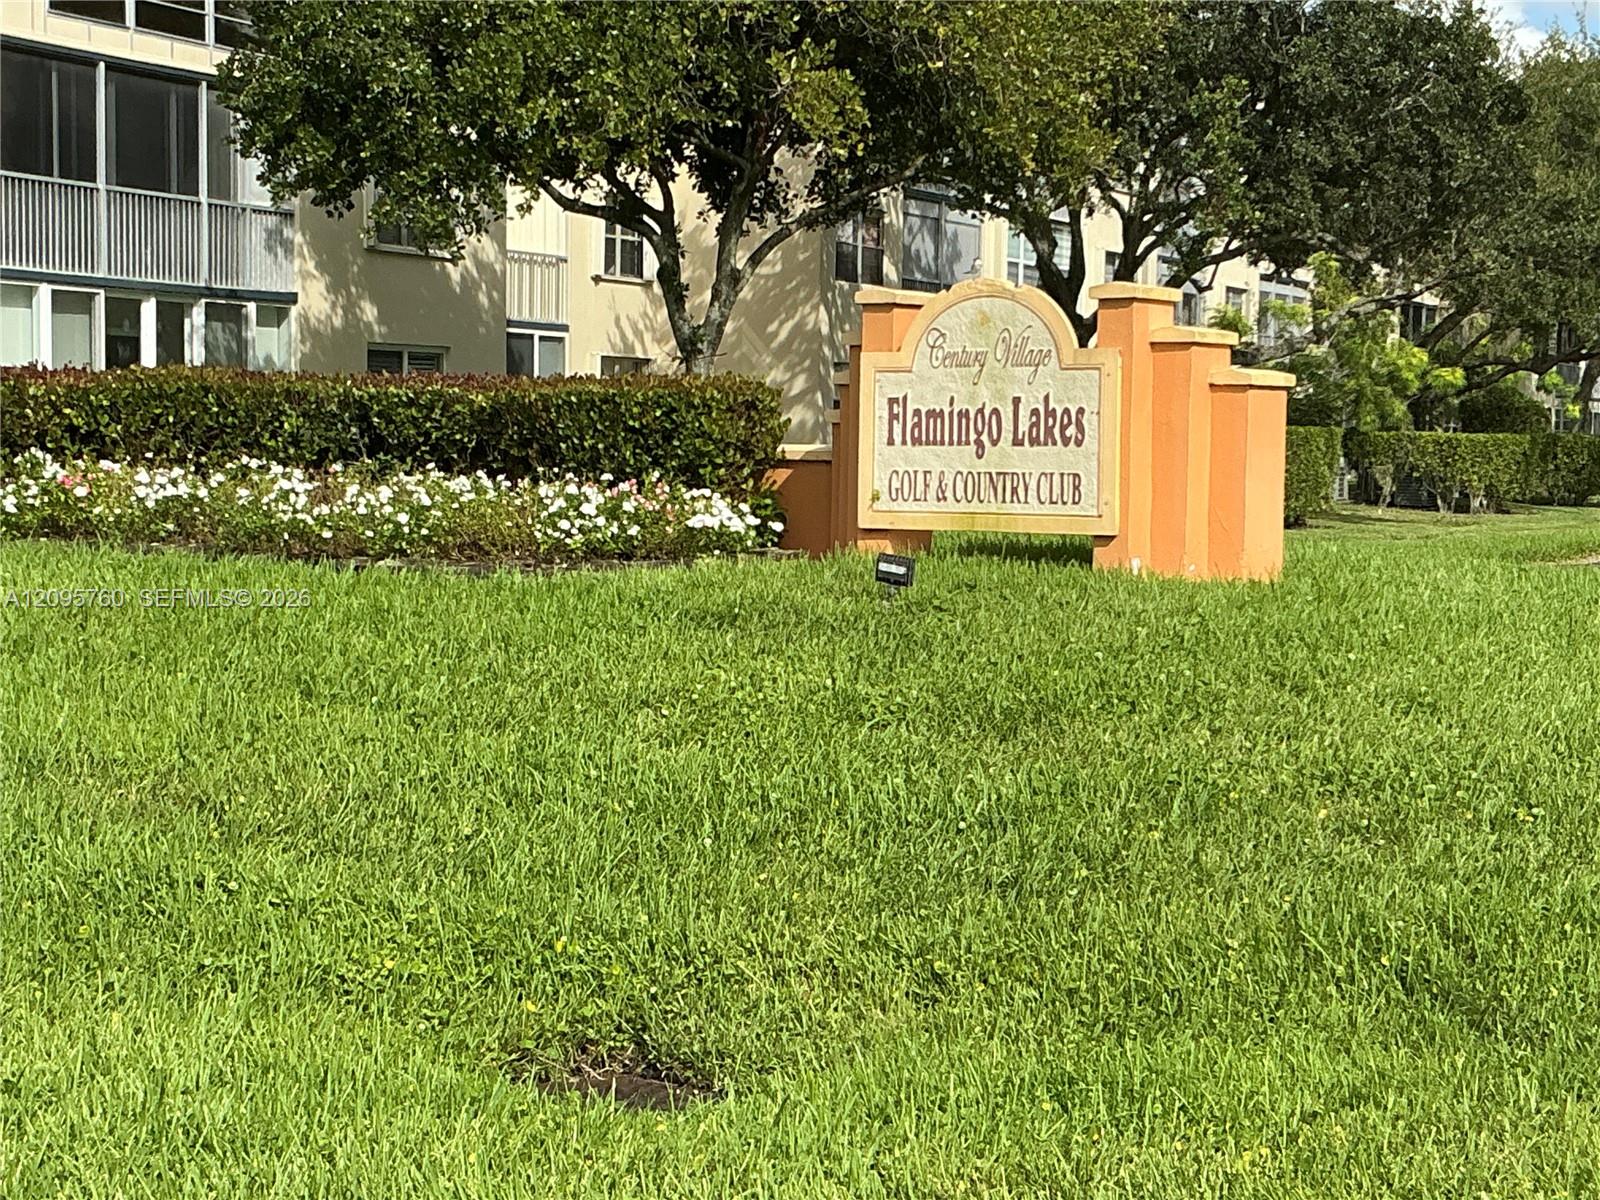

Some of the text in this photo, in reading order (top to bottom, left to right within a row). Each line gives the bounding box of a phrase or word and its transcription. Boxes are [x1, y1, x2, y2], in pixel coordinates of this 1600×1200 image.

[926, 325, 1052, 385] Century Village
[887, 392, 1086, 459] Flamingo Lakes
[888, 469, 1082, 506] GOLF & COUNTRY CLUB
